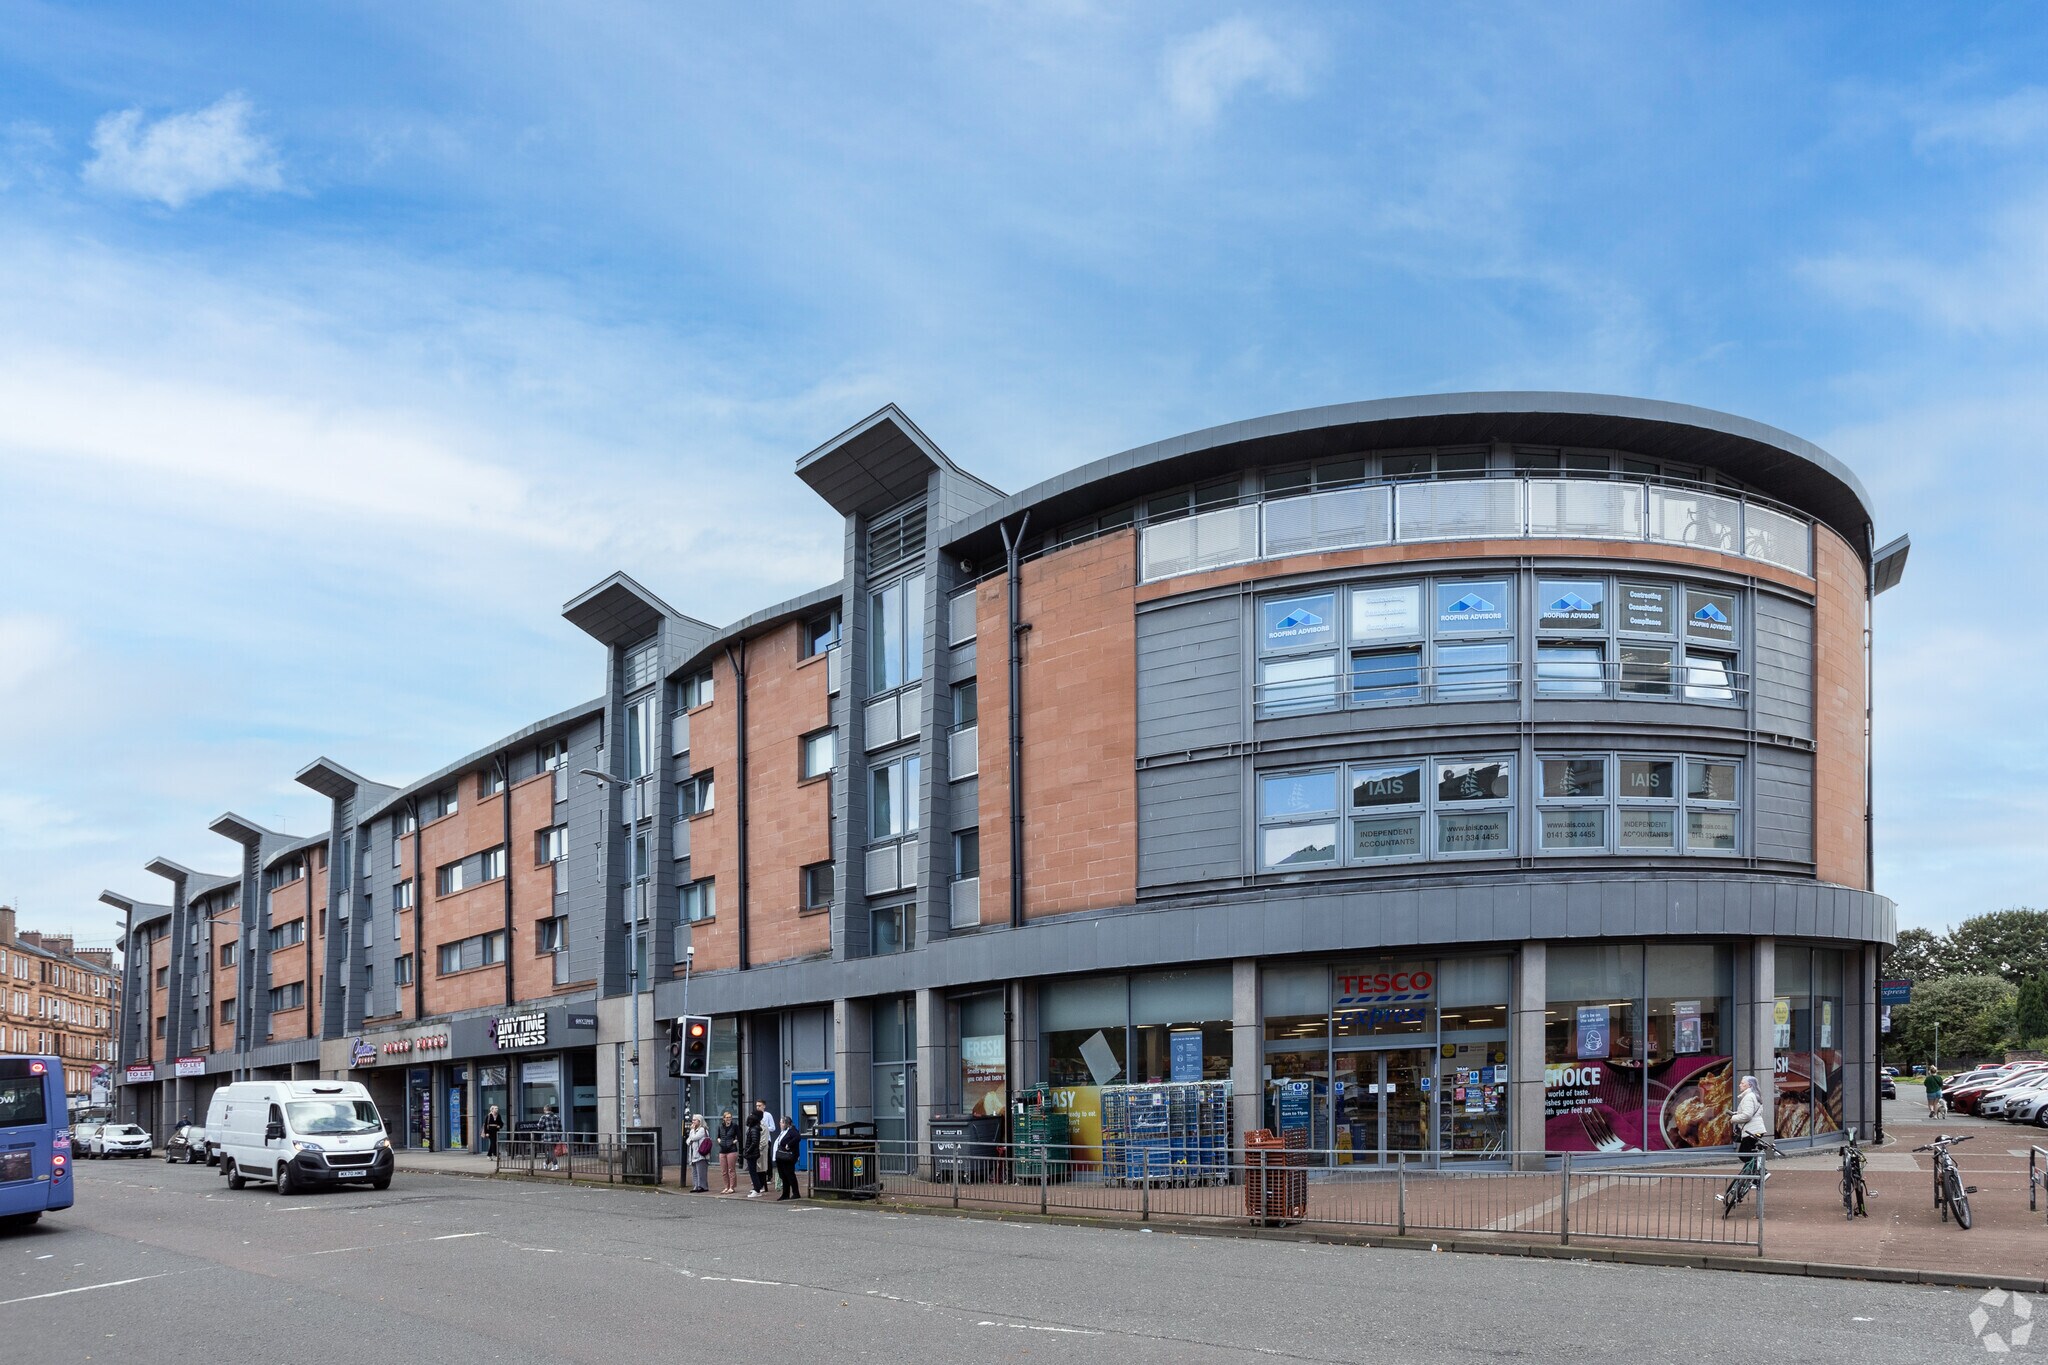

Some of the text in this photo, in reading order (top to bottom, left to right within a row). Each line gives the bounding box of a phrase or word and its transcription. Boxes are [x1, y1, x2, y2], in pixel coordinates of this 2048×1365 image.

[1629, 590, 1662, 601] Contracting
[1628, 603, 1663, 612] Consultation
[1440, 614, 1469, 622] ROOFING
[1629, 616, 1662, 626] Compliance
[1269, 625, 1330, 638] ROOFING ADVISORS
[1689, 620, 1732, 632] ROOFING ADVISORS
[1631, 772, 1660, 788] IAIS
[1368, 780, 1404, 796] IAIS
[1446, 823, 1499, 832] www.iais.co.uk
[1546, 821, 1596, 829] www.iais.co.uk
[1360, 828, 1414, 838] INDEPENDENT
[1446, 833, 1500, 843] 0141 334 4455
[1546, 831, 1563, 839] 0141
[1564, 831, 1578, 839] 334
[1359, 838, 1415, 848] ACCOUNTANTS
[1338, 972, 1433, 994] TESCO
[498, 1013, 546, 1035] ANYTIME
[1341, 1008, 1426, 1031] express
[384, 1035, 445, 1055] BINGO BINGO
[498, 1031, 546, 1049] FITNESS
[967, 1040, 1002, 1058] FRESH
[1545, 1067, 1601, 1087] CHOICE
[1281, 1082, 1309, 1091] HEO
[1050, 1091, 1076, 1108] ASY
[1556, 1108, 1570, 1116] your
